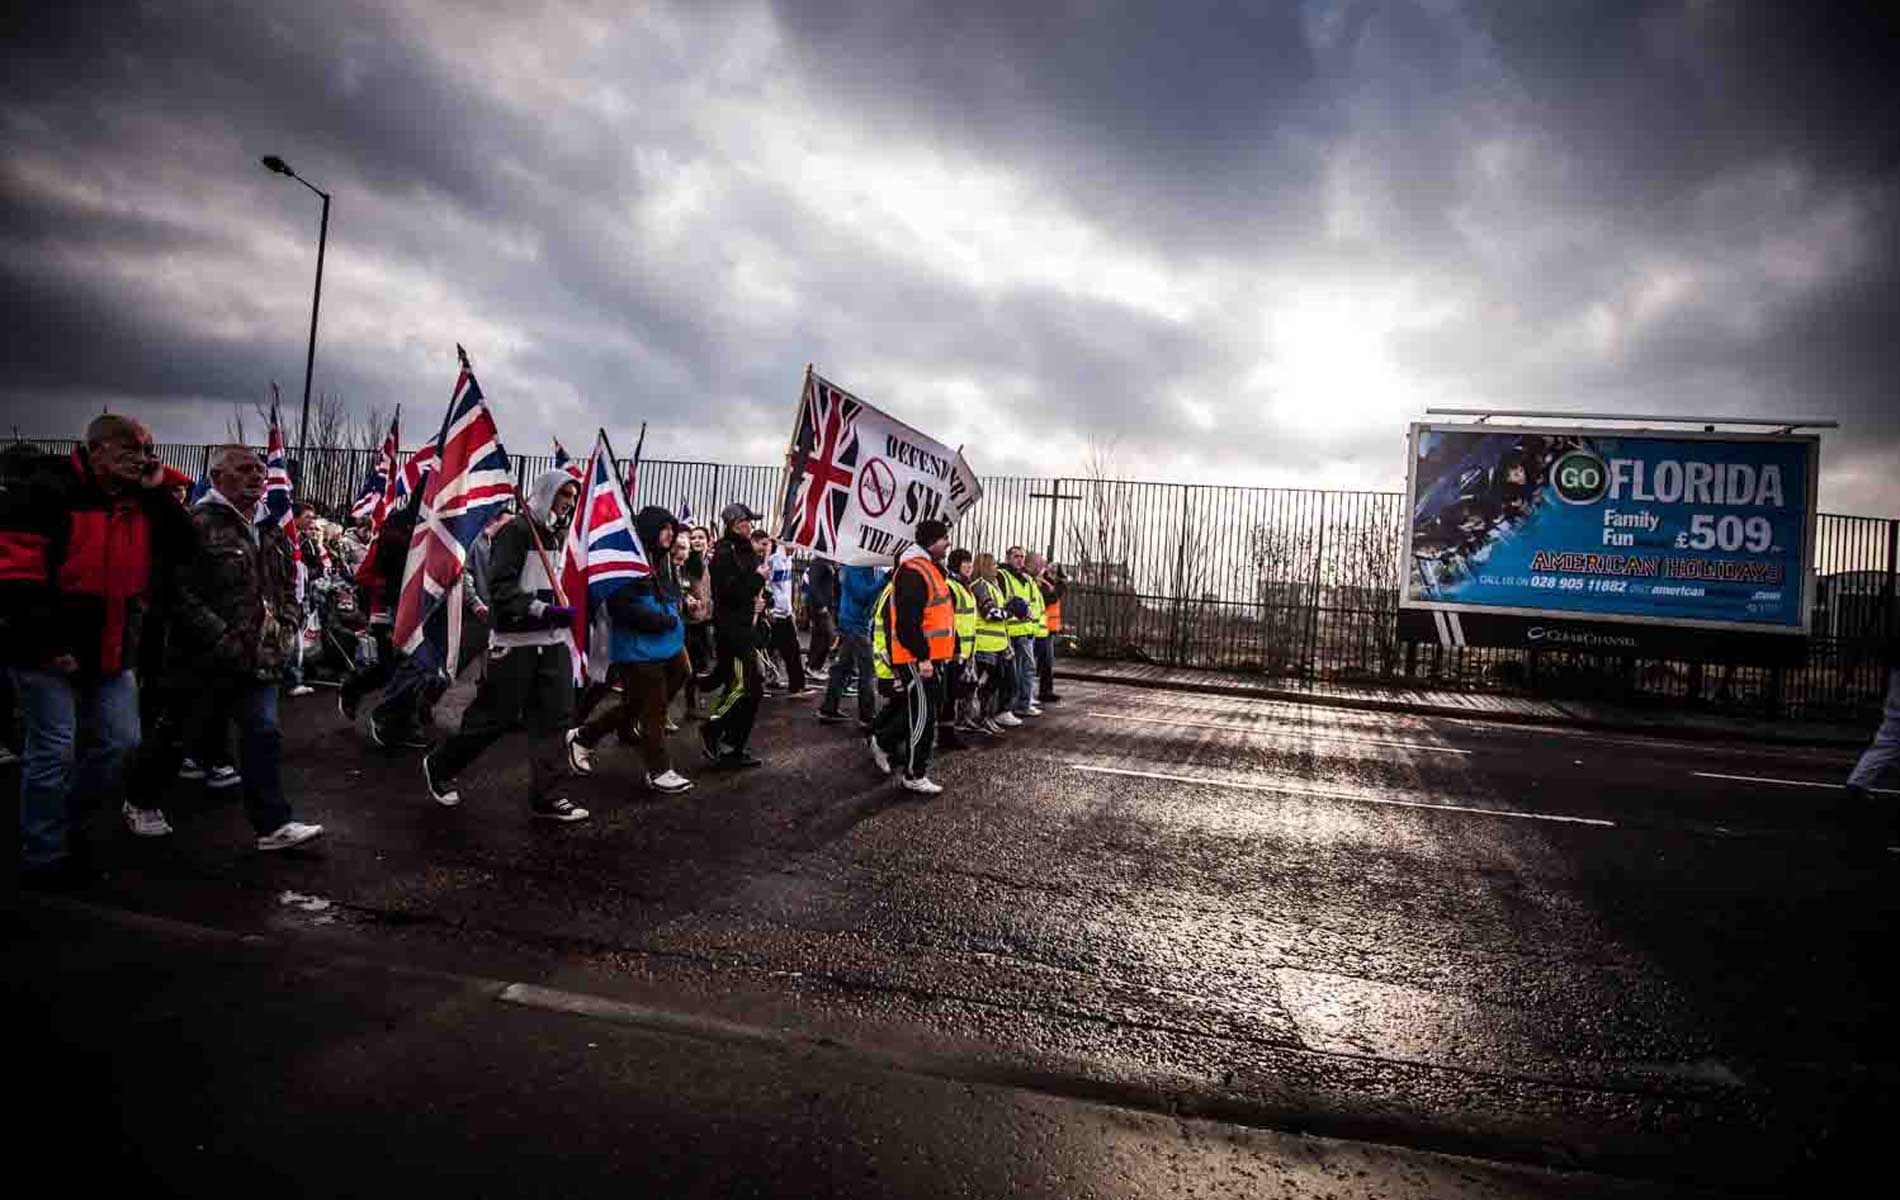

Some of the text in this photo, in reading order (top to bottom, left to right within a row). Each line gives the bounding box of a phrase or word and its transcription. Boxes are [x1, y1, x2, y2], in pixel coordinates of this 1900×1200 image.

[1561, 458, 1784, 507] GO FLORIDA
[1604, 509, 1660, 531] Family
[859, 524, 893, 556] THE
[1603, 529, 1634, 547] Fun
[1531, 550, 1661, 577] AMERICAN
[1531, 575, 1556, 588] 028
[1559, 577, 1584, 590] 905
[1651, 585, 1706, 598] american
